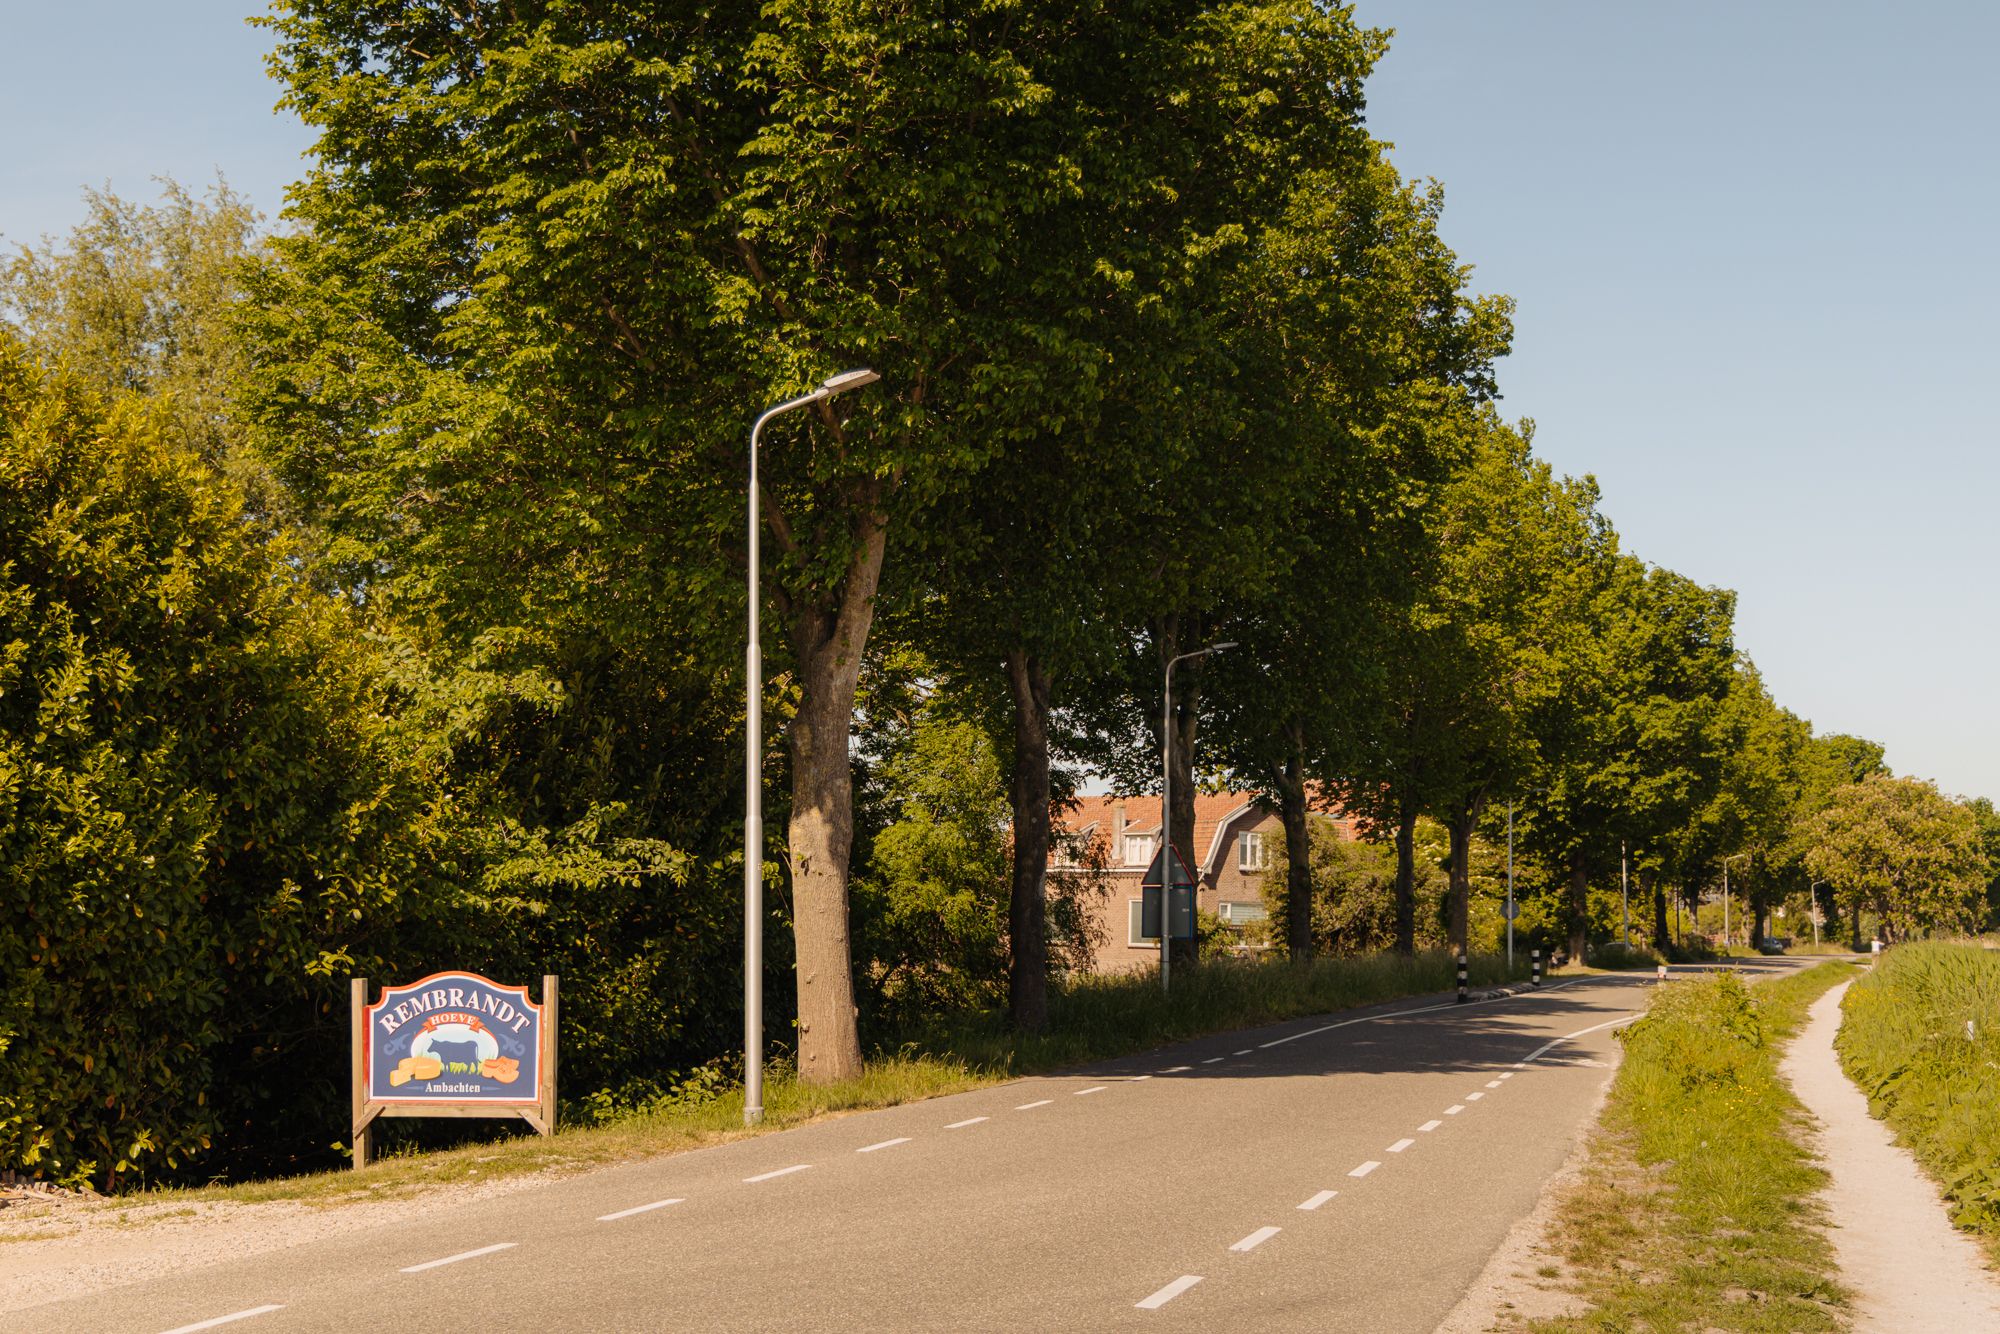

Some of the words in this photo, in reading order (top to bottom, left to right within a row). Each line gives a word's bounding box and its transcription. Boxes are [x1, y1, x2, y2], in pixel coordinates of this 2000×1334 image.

[379, 988, 531, 1035] REMBRANDT
[430, 1013, 476, 1026] HOEVE
[425, 1082, 481, 1093] Ambachten
